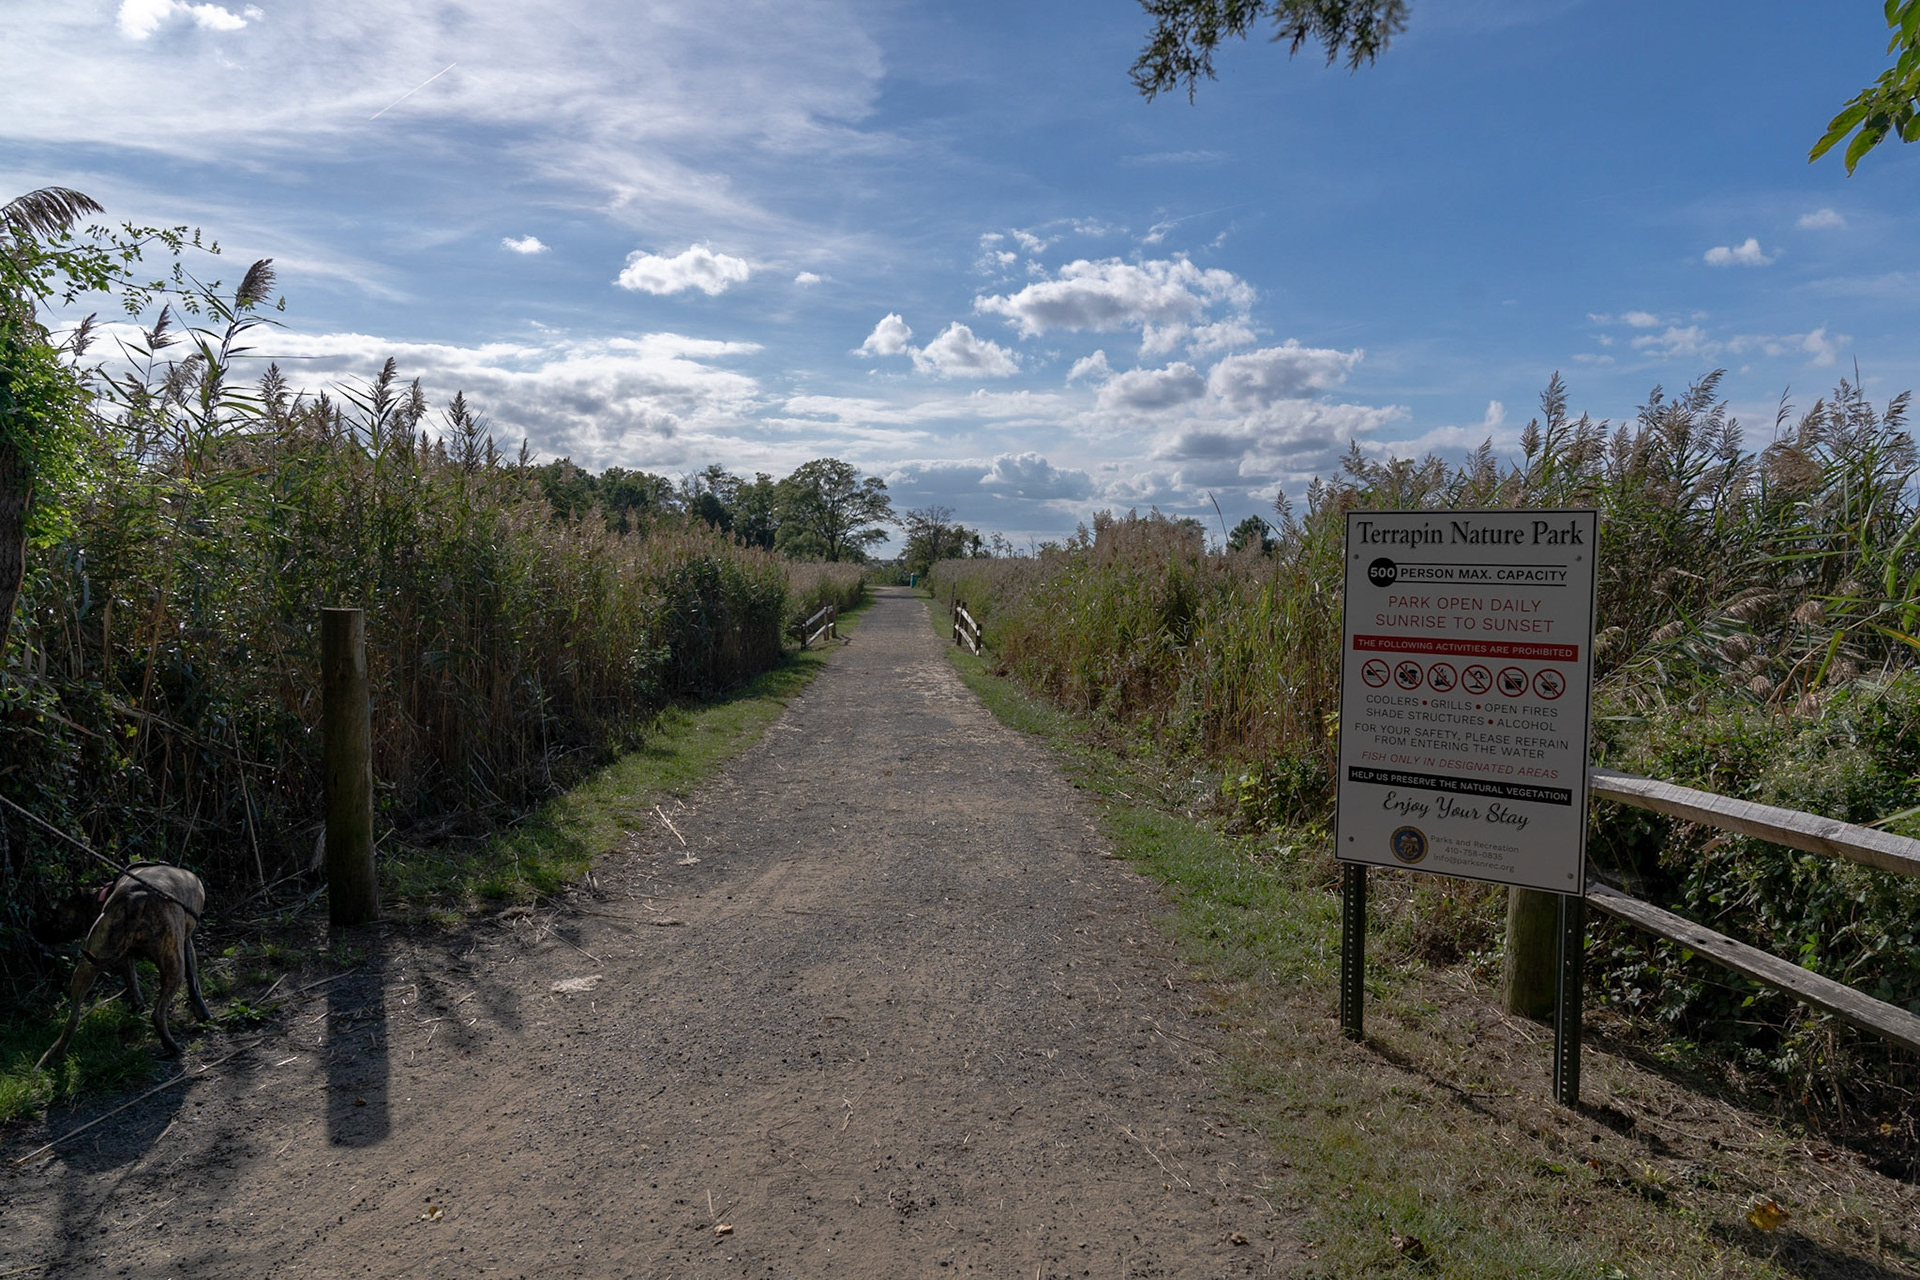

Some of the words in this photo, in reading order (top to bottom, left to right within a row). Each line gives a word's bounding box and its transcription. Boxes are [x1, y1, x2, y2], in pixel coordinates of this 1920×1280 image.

[1357, 521, 1443, 548] Terrapin
[1450, 521, 1525, 545] Nature
[1531, 520, 1583, 545] Park
[1370, 567, 1395, 578] 500
[1401, 568, 1453, 579] PERSON
[1458, 569, 1492, 579] MAX.
[1497, 570, 1567, 581] CAPACITY
[1388, 596, 1431, 608] PARK
[1437, 597, 1483, 611] OPEN
[1491, 599, 1541, 612] DAILY
[1376, 614, 1447, 629] SUNRISE
[1454, 617, 1476, 630] TO
[1482, 618, 1554, 633] SUNSET
[1359, 639, 1375, 647] THE
[1378, 640, 1433, 650] FOLLOWING
[1436, 643, 1487, 653] ACTIVITIES
[1490, 645, 1509, 654] ARE
[1512, 647, 1572, 657] PROHIBITED
[1366, 695, 1419, 706] COOLERS
[1431, 699, 1472, 711] GRILLS
[1484, 703, 1517, 714] OPEN
[1523, 706, 1558, 717] FIRES
[1366, 708, 1404, 719] SHADE
[1408, 712, 1485, 725] STRUCTURES
[1497, 719, 1556, 731] ALCOHOL
[1355, 723, 1376, 732] FOR
[1380, 725, 1410, 736] YOUR
[1415, 728, 1461, 741] SAFETY,
[1466, 733, 1510, 745] PLEASE
[1515, 737, 1569, 750] REFRAIN
[1375, 735, 1406, 746] FROM
[1411, 739, 1469, 752] ENTERING
[1473, 744, 1496, 755] THE
[1501, 747, 1544, 759] WATER
[1362, 751, 1386, 762] FISH
[1390, 754, 1420, 766] ONLY
[1424, 758, 1435, 767] IN
[1439, 759, 1514, 775] DESIGNATED
[1517, 767, 1559, 779] AREAS
[1352, 771, 1374, 780] HELP
[1376, 773, 1388, 781] US
[1391, 775, 1436, 787] PRESERVE
[1439, 780, 1457, 790] THE
[1460, 782, 1503, 794] NATURAL
[1506, 787, 1568, 801] VEGETATION
[1383, 791, 1430, 819] Enjoy
[1435, 796, 1481, 820] Your
[1486, 803, 1530, 831] Stay
[1431, 835, 1453, 844] Parks
[1474, 841, 1519, 853] Recreation
[1445, 847, 1503, 860] 410-758-0835
